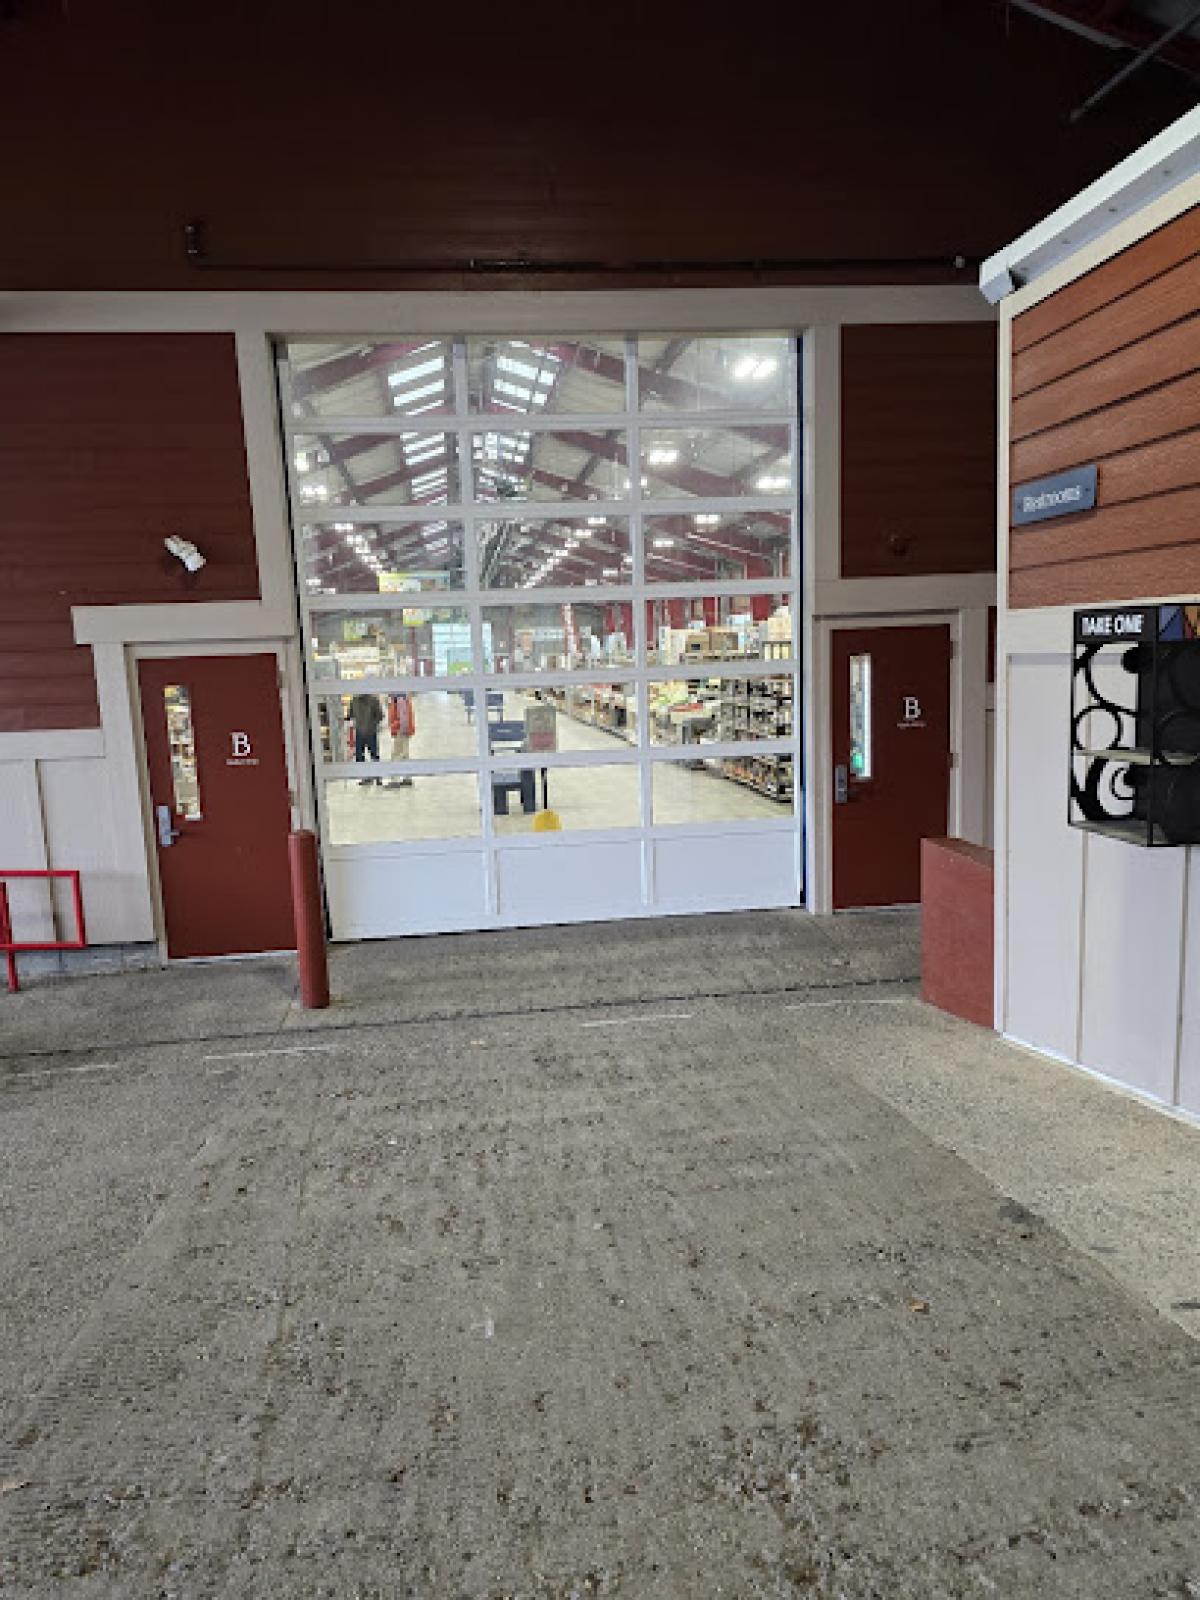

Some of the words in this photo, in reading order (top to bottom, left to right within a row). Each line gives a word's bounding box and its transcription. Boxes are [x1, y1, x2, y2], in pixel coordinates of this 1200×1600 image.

[1081, 615, 1112, 635] TAKE
[1114, 614, 1144, 634] ONE
[902, 696, 921, 720] B
[230, 731, 251, 757] B
